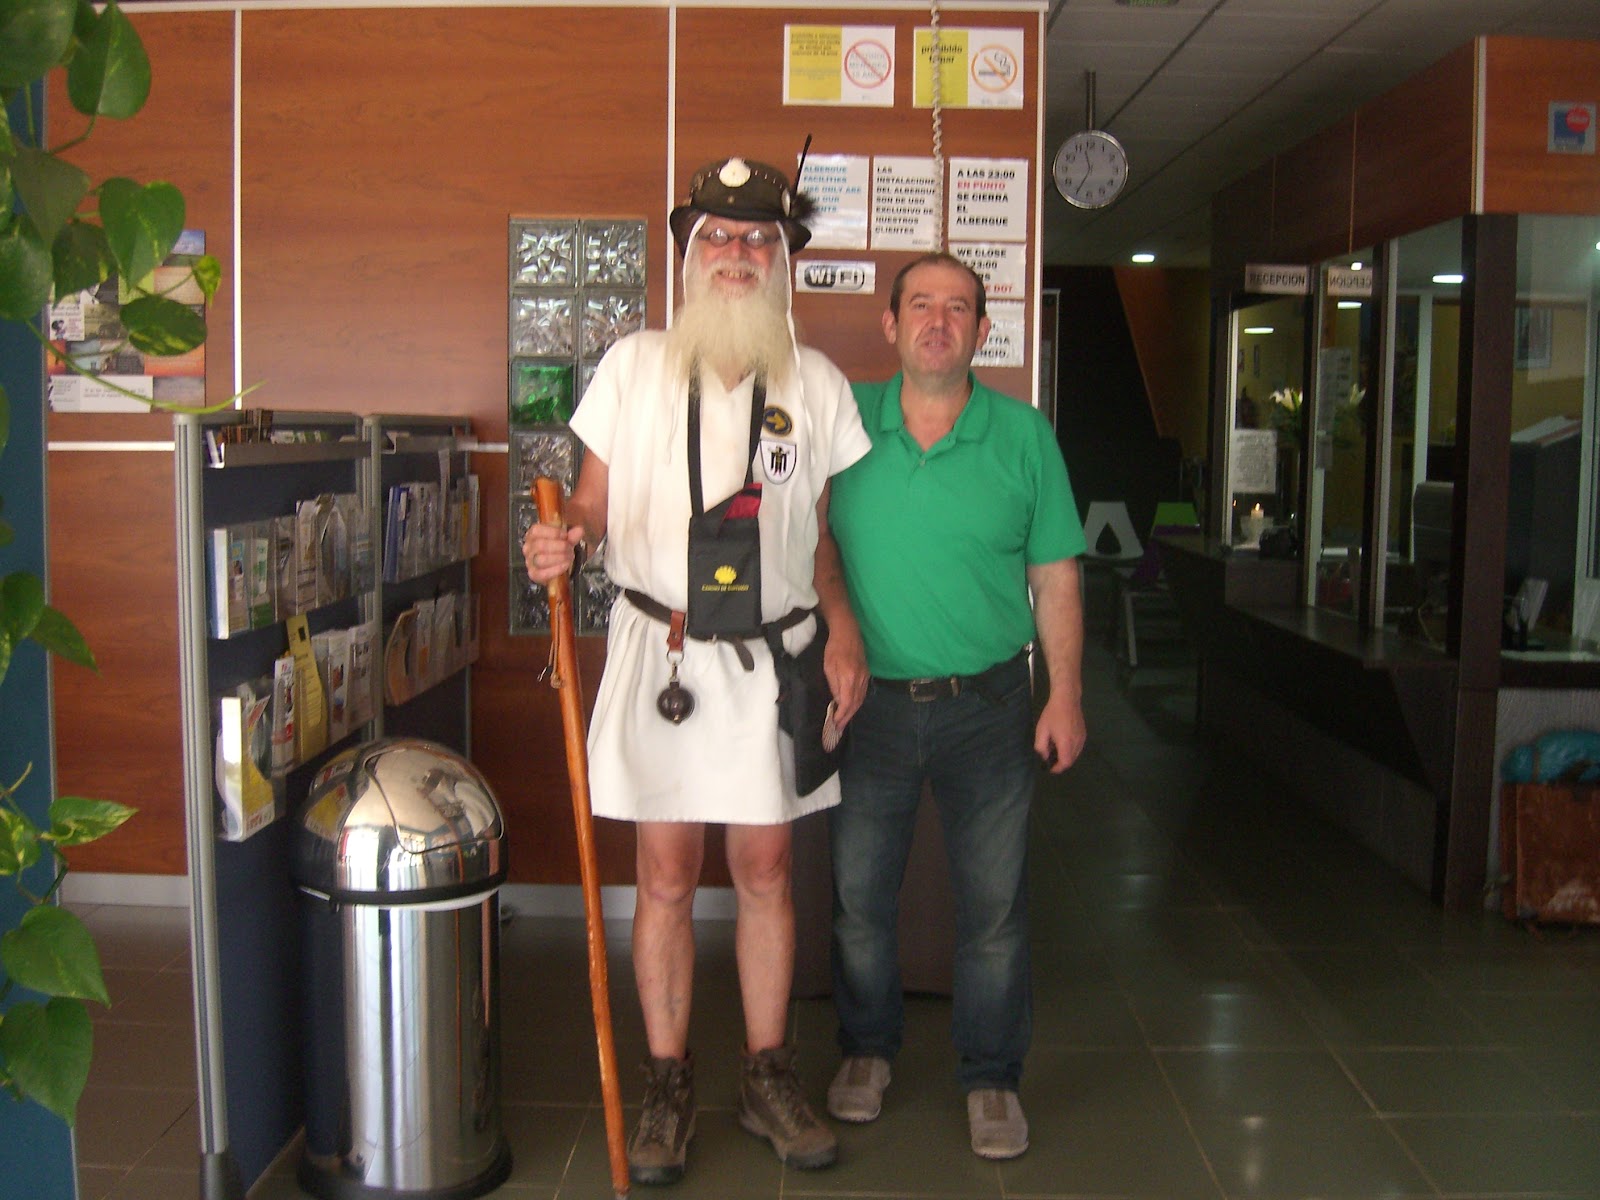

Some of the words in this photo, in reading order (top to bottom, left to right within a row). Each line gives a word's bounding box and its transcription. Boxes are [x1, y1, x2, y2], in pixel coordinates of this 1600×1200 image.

[921, 44, 962, 54] proibido
[929, 56, 954, 64] fmar
[1075, 144, 1082, 152] 11
[1086, 141, 1095, 150] 12
[804, 165, 847, 173] ALBERGUE
[803, 175, 847, 183] FACILITIES
[957, 169, 964, 178] A
[967, 169, 985, 178] LAS
[988, 170, 1015, 180] 23:00
[877, 177, 936, 185] INSTALACIONE
[957, 180, 970, 189] EN
[973, 181, 1005, 190] PUNTO
[908, 197, 925, 205] USO
[956, 193, 969, 202] SE
[972, 193, 1008, 203] CIERRA
[876, 206, 921, 215] EXCLUSIVO
[956, 204, 968, 214] EL
[875, 217, 919, 225] NUESTROS
[956, 216, 1008, 226] ALBERGUE
[875, 227, 914, 235] CLIENTES
[957, 248, 972, 257] WE
[975, 248, 1007, 258] CLOSE
[994, 285, 1013, 294] DOT
